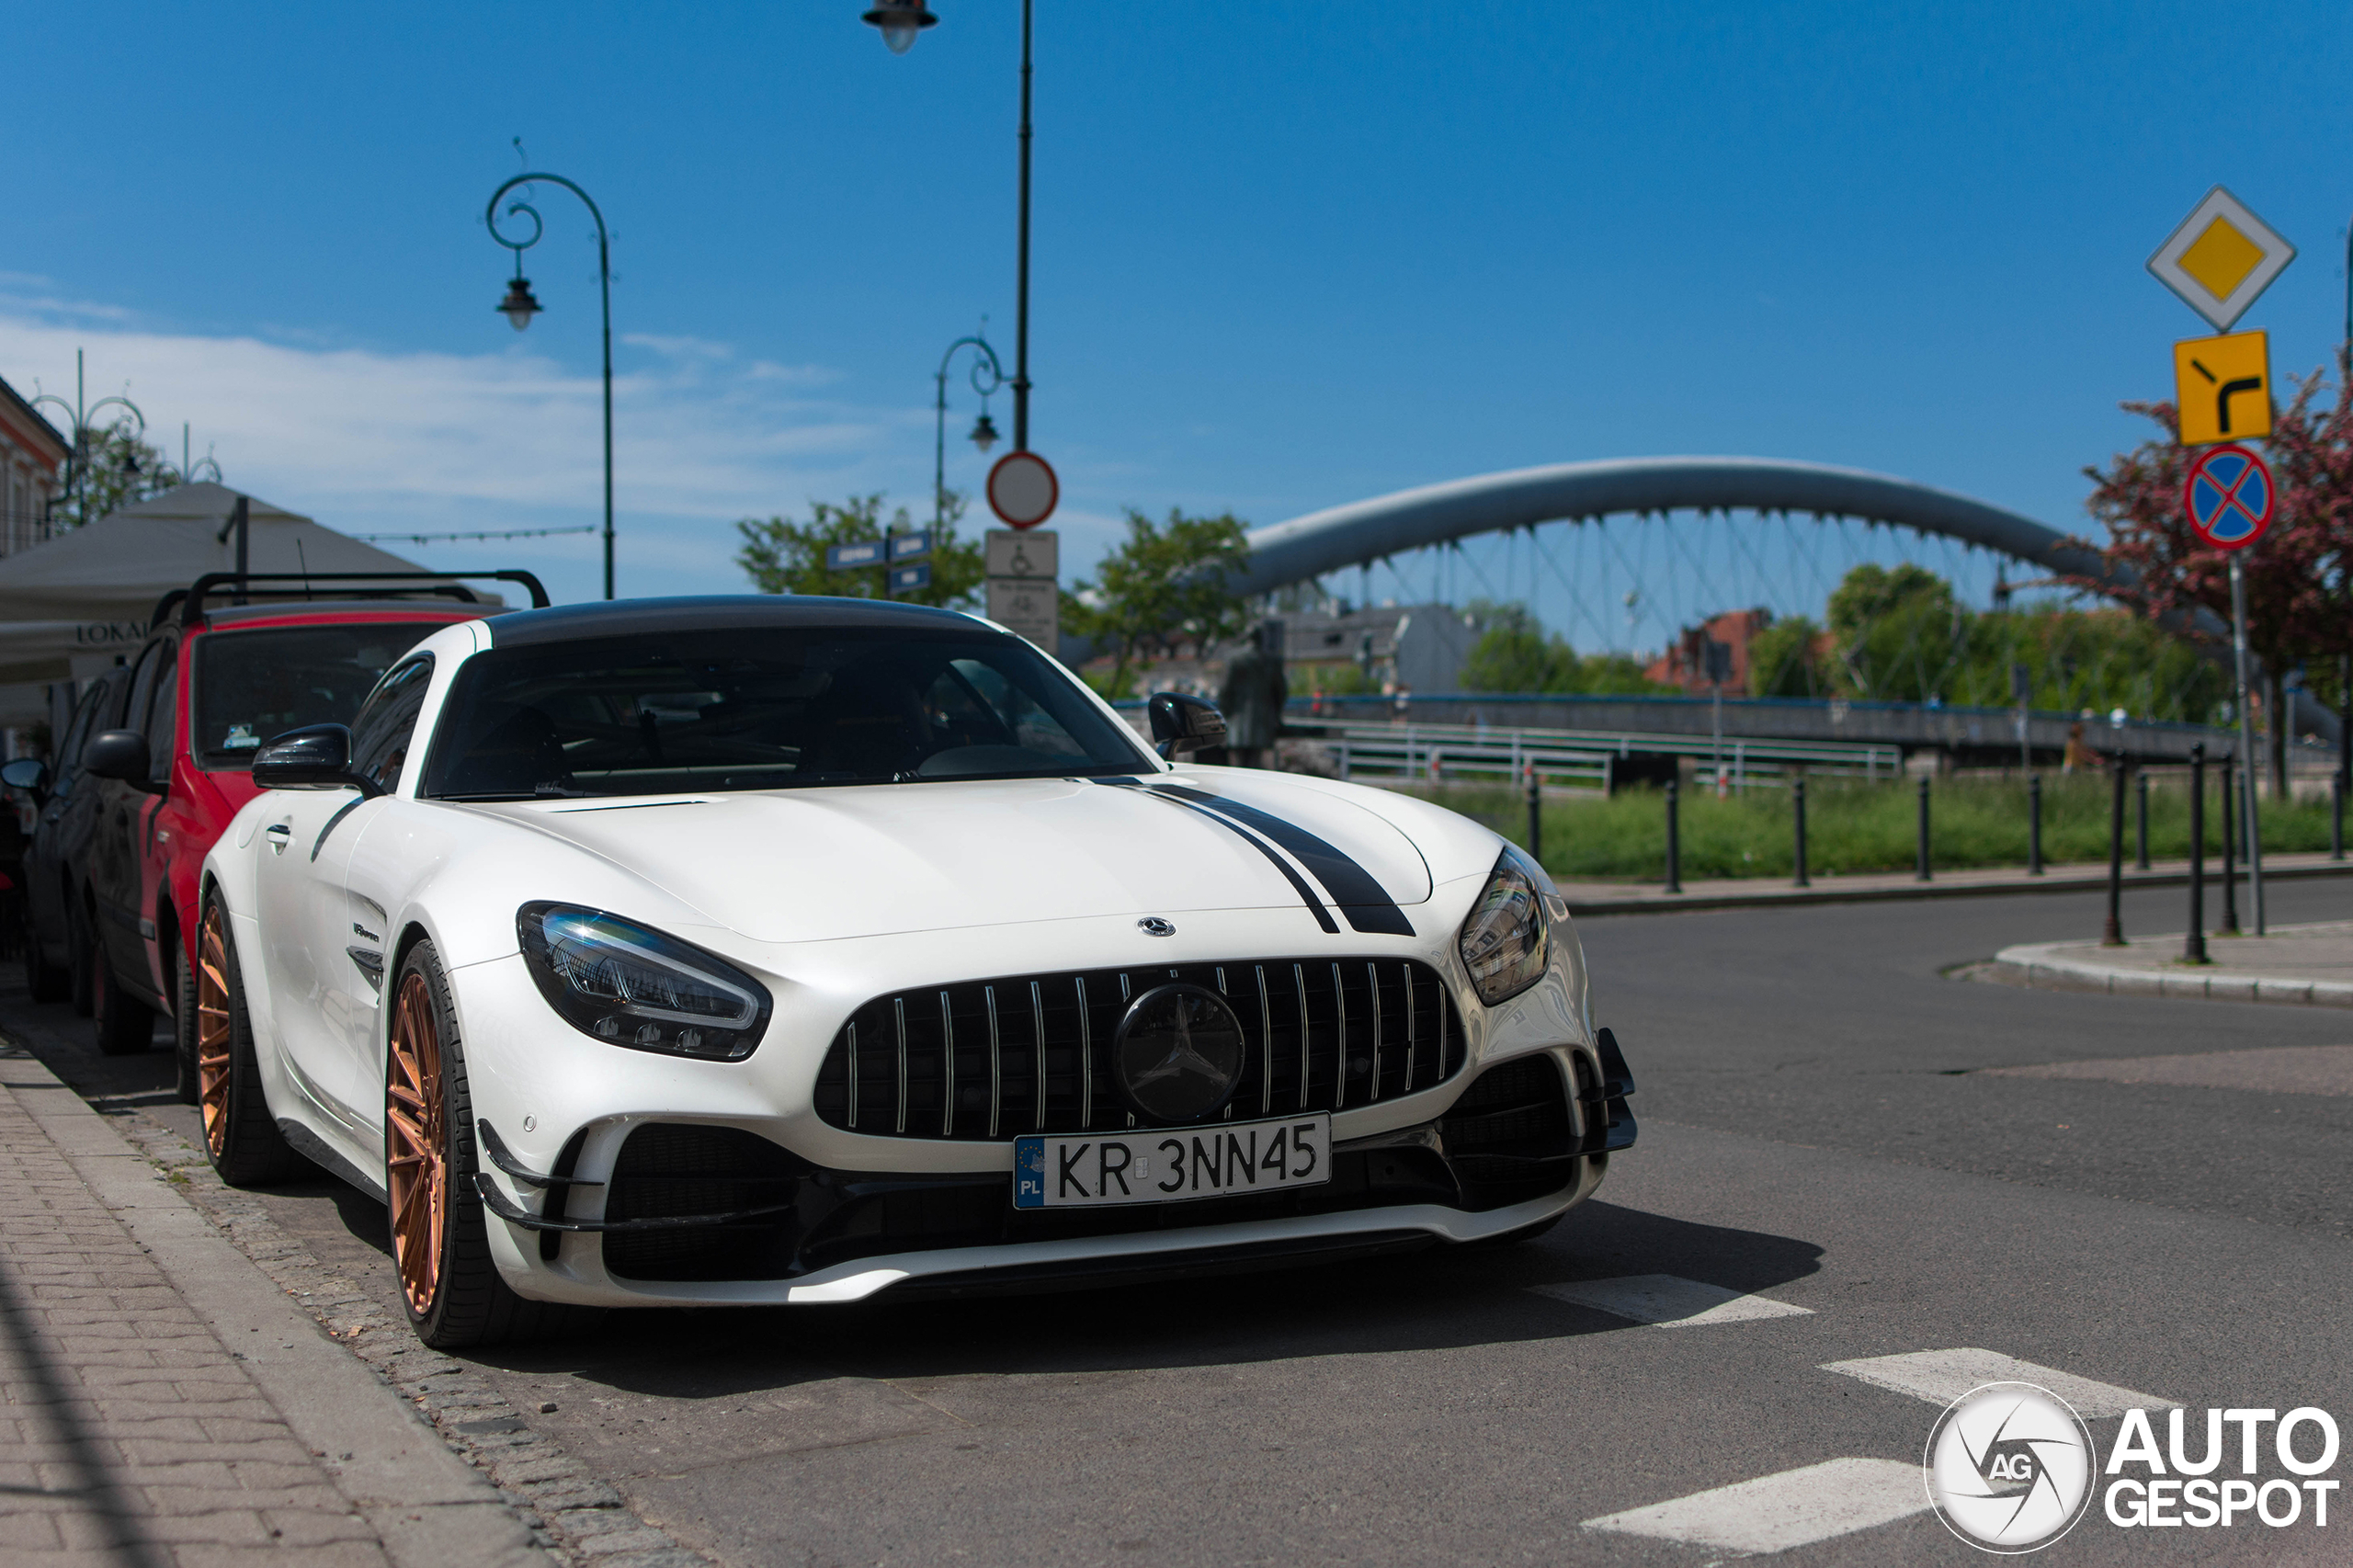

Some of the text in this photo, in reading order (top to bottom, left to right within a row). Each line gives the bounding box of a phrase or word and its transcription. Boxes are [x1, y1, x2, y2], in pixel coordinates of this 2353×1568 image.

[1059, 1122, 1317, 1199] KR 3NN45
[1020, 1180, 1040, 1195] PL
